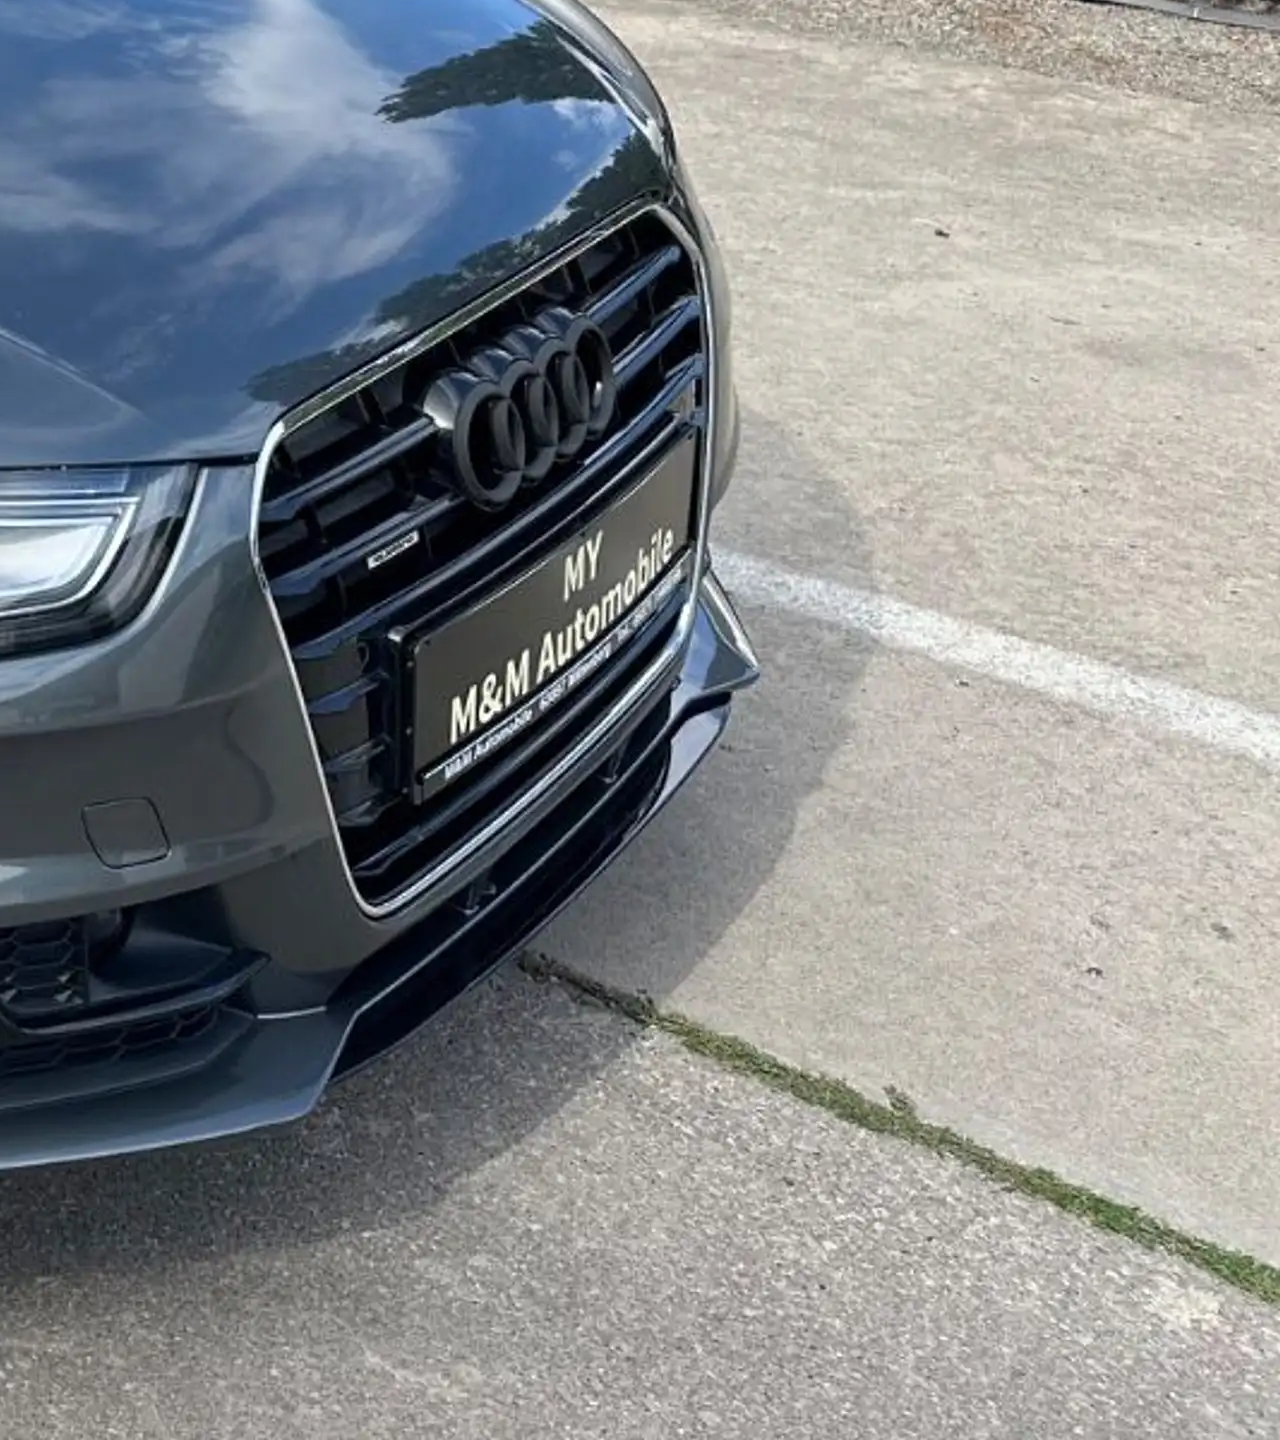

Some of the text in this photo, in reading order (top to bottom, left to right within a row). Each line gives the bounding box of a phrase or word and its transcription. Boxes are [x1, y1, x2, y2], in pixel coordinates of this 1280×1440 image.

[449, 647, 531, 745] M&M
[536, 527, 675, 685] Automobile
[563, 529, 604, 602] MY
